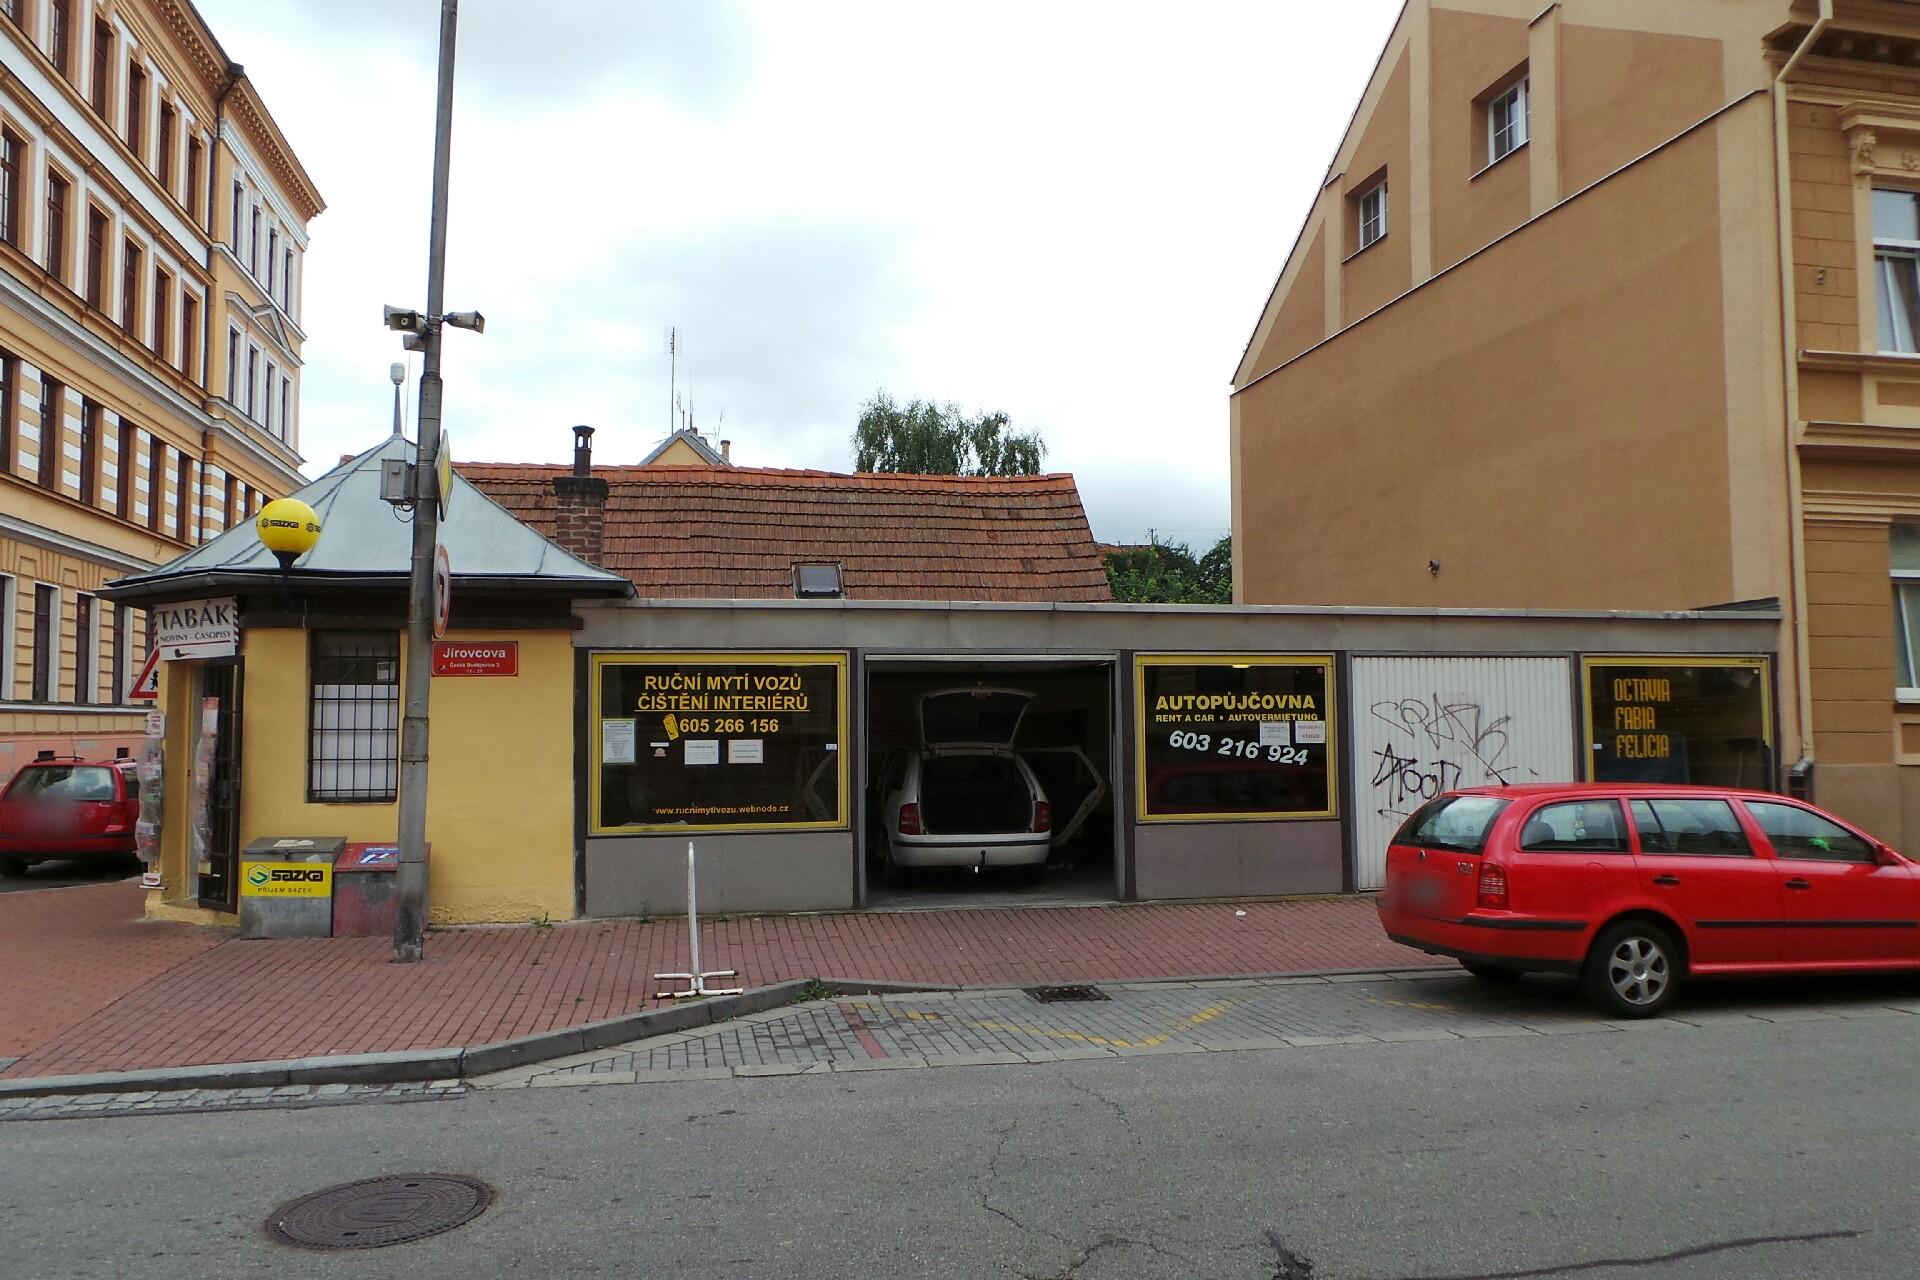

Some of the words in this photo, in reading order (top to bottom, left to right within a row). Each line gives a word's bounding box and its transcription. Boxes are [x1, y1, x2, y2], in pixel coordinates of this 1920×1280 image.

[159, 601, 231, 631] TABÁK
[160, 632, 188, 643] NOVINY
[194, 630, 231, 641] ČASOPISY
[645, 673, 702, 691] RUČNÍ
[706, 673, 750, 691] MYTÍ
[754, 673, 802, 690] VOZŮ
[1614, 678, 1670, 702] OCTAVIA
[637, 693, 709, 711] ČIŠTĚNÍ
[714, 692, 809, 710] INTERIÉRŮ
[1155, 692, 1315, 710] AUTOPŮJČOVNA
[679, 718, 710, 733] 605
[714, 718, 745, 733] 266
[750, 718, 779, 733] 156
[1155, 714, 1182, 722] RENT
[1184, 714, 1192, 722] A
[1194, 714, 1215, 722] CAR
[1615, 706, 1656, 730] FABIA
[1169, 730, 1211, 751] 603
[1217, 737, 1260, 759] 216
[1267, 744, 1309, 766] 924
[1616, 734, 1670, 759] FELICIA
[655, 805, 790, 816] www.rucnimytivozu.webnode.cz
